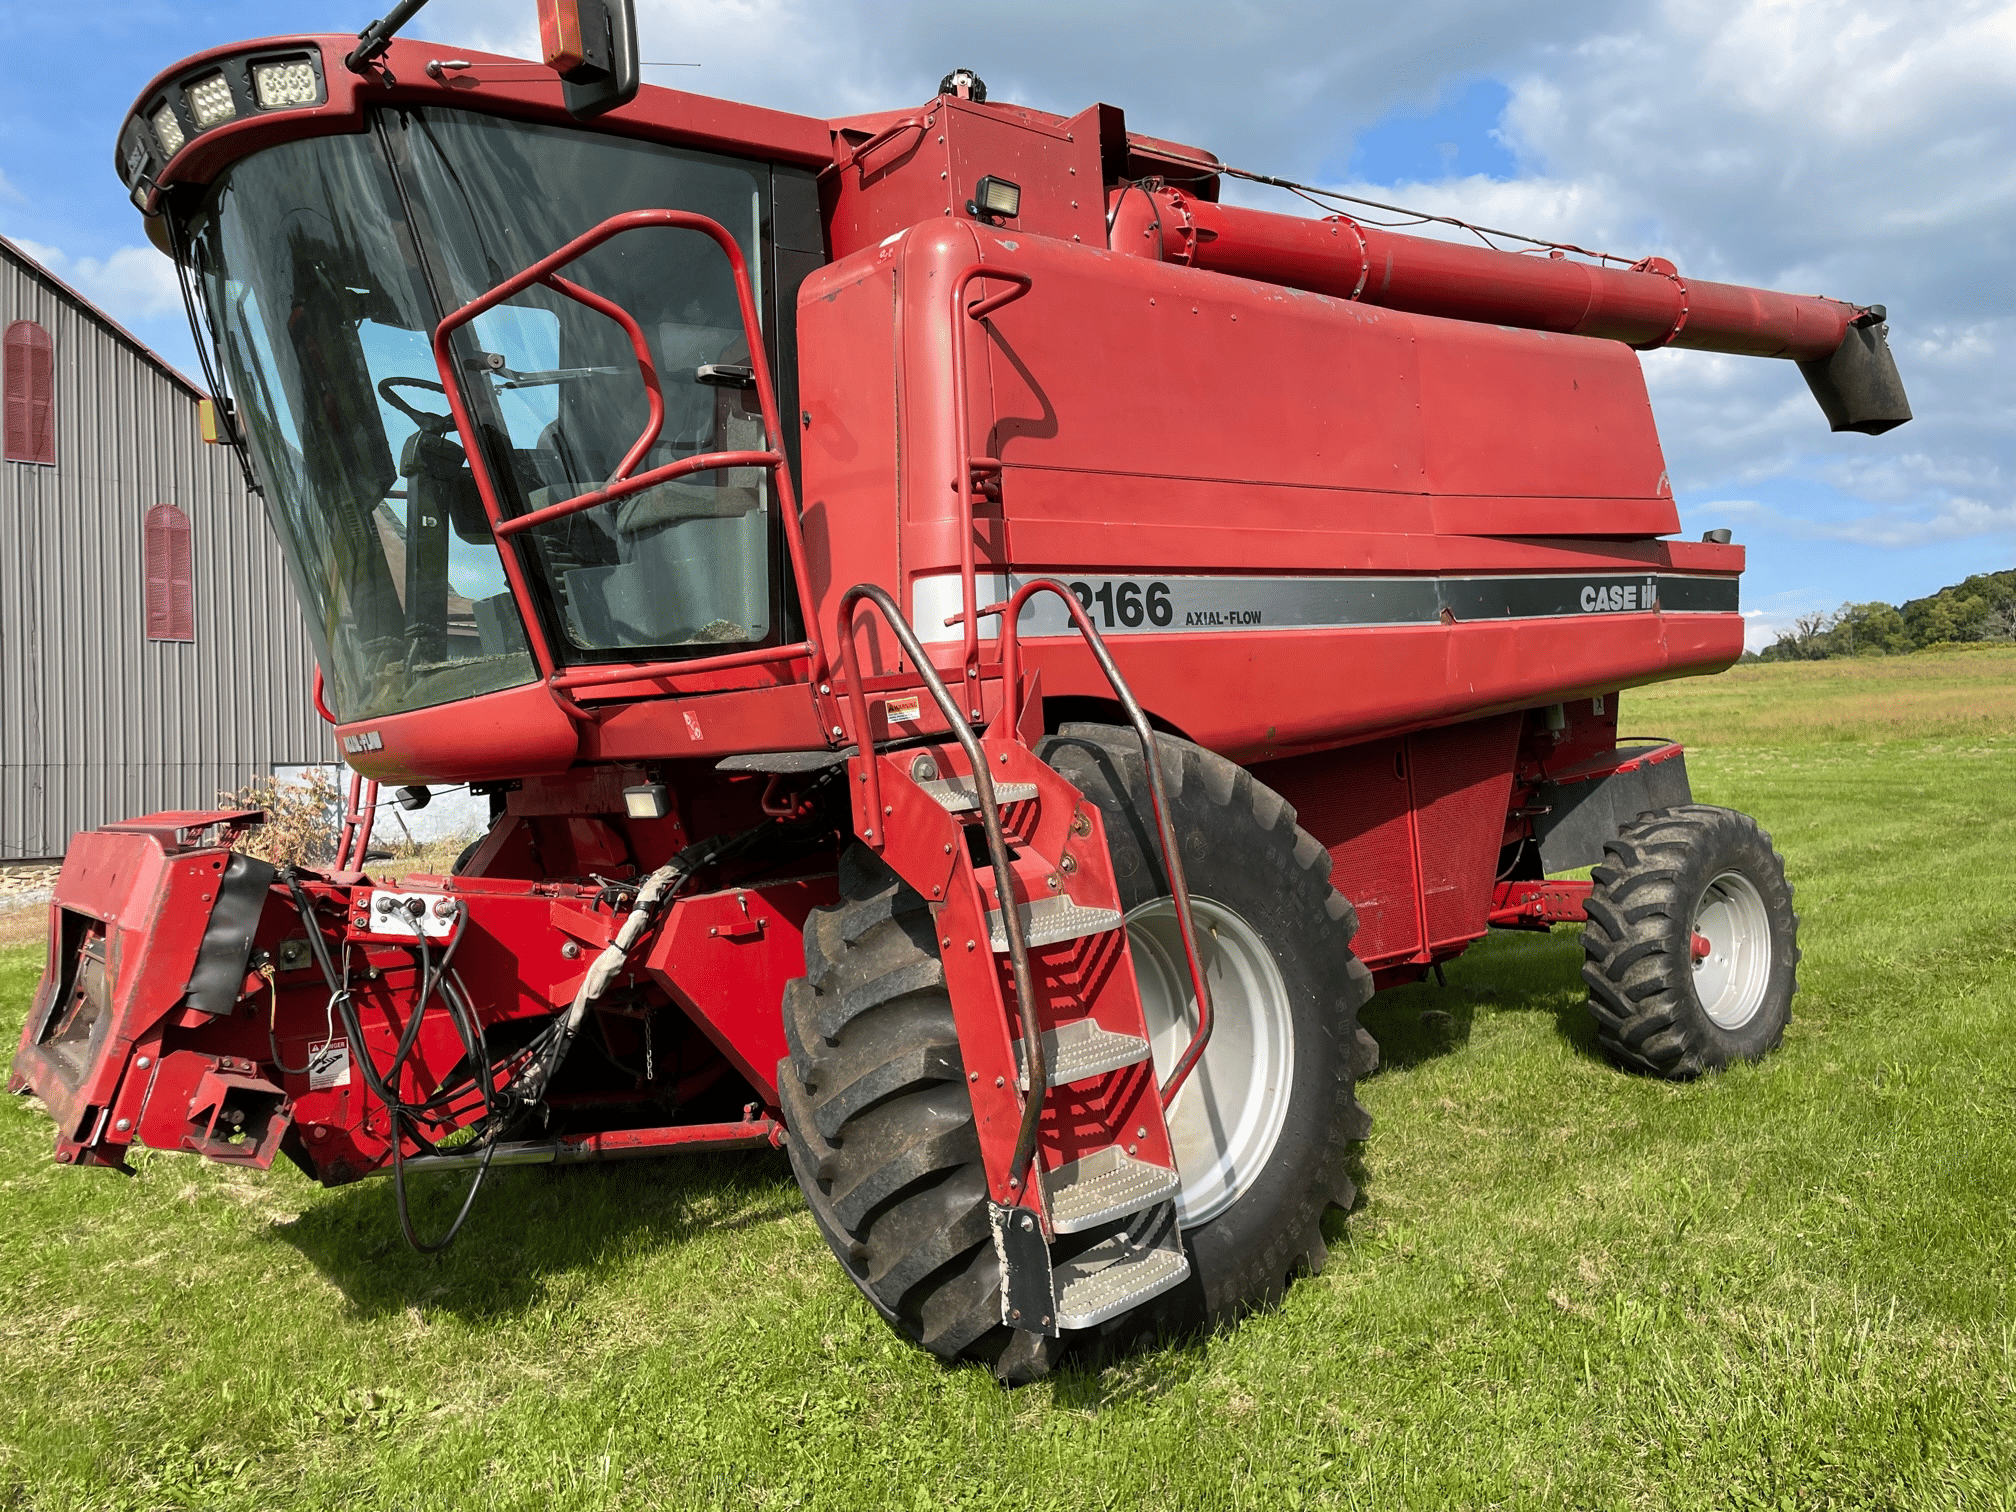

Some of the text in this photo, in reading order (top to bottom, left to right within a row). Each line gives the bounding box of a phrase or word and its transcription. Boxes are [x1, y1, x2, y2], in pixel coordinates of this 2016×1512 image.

[1068, 581, 1262, 628] 2166 AXIAL-FLOW
[1580, 586, 1638, 612] CASE
[320, 1042, 345, 1051] DNGER
